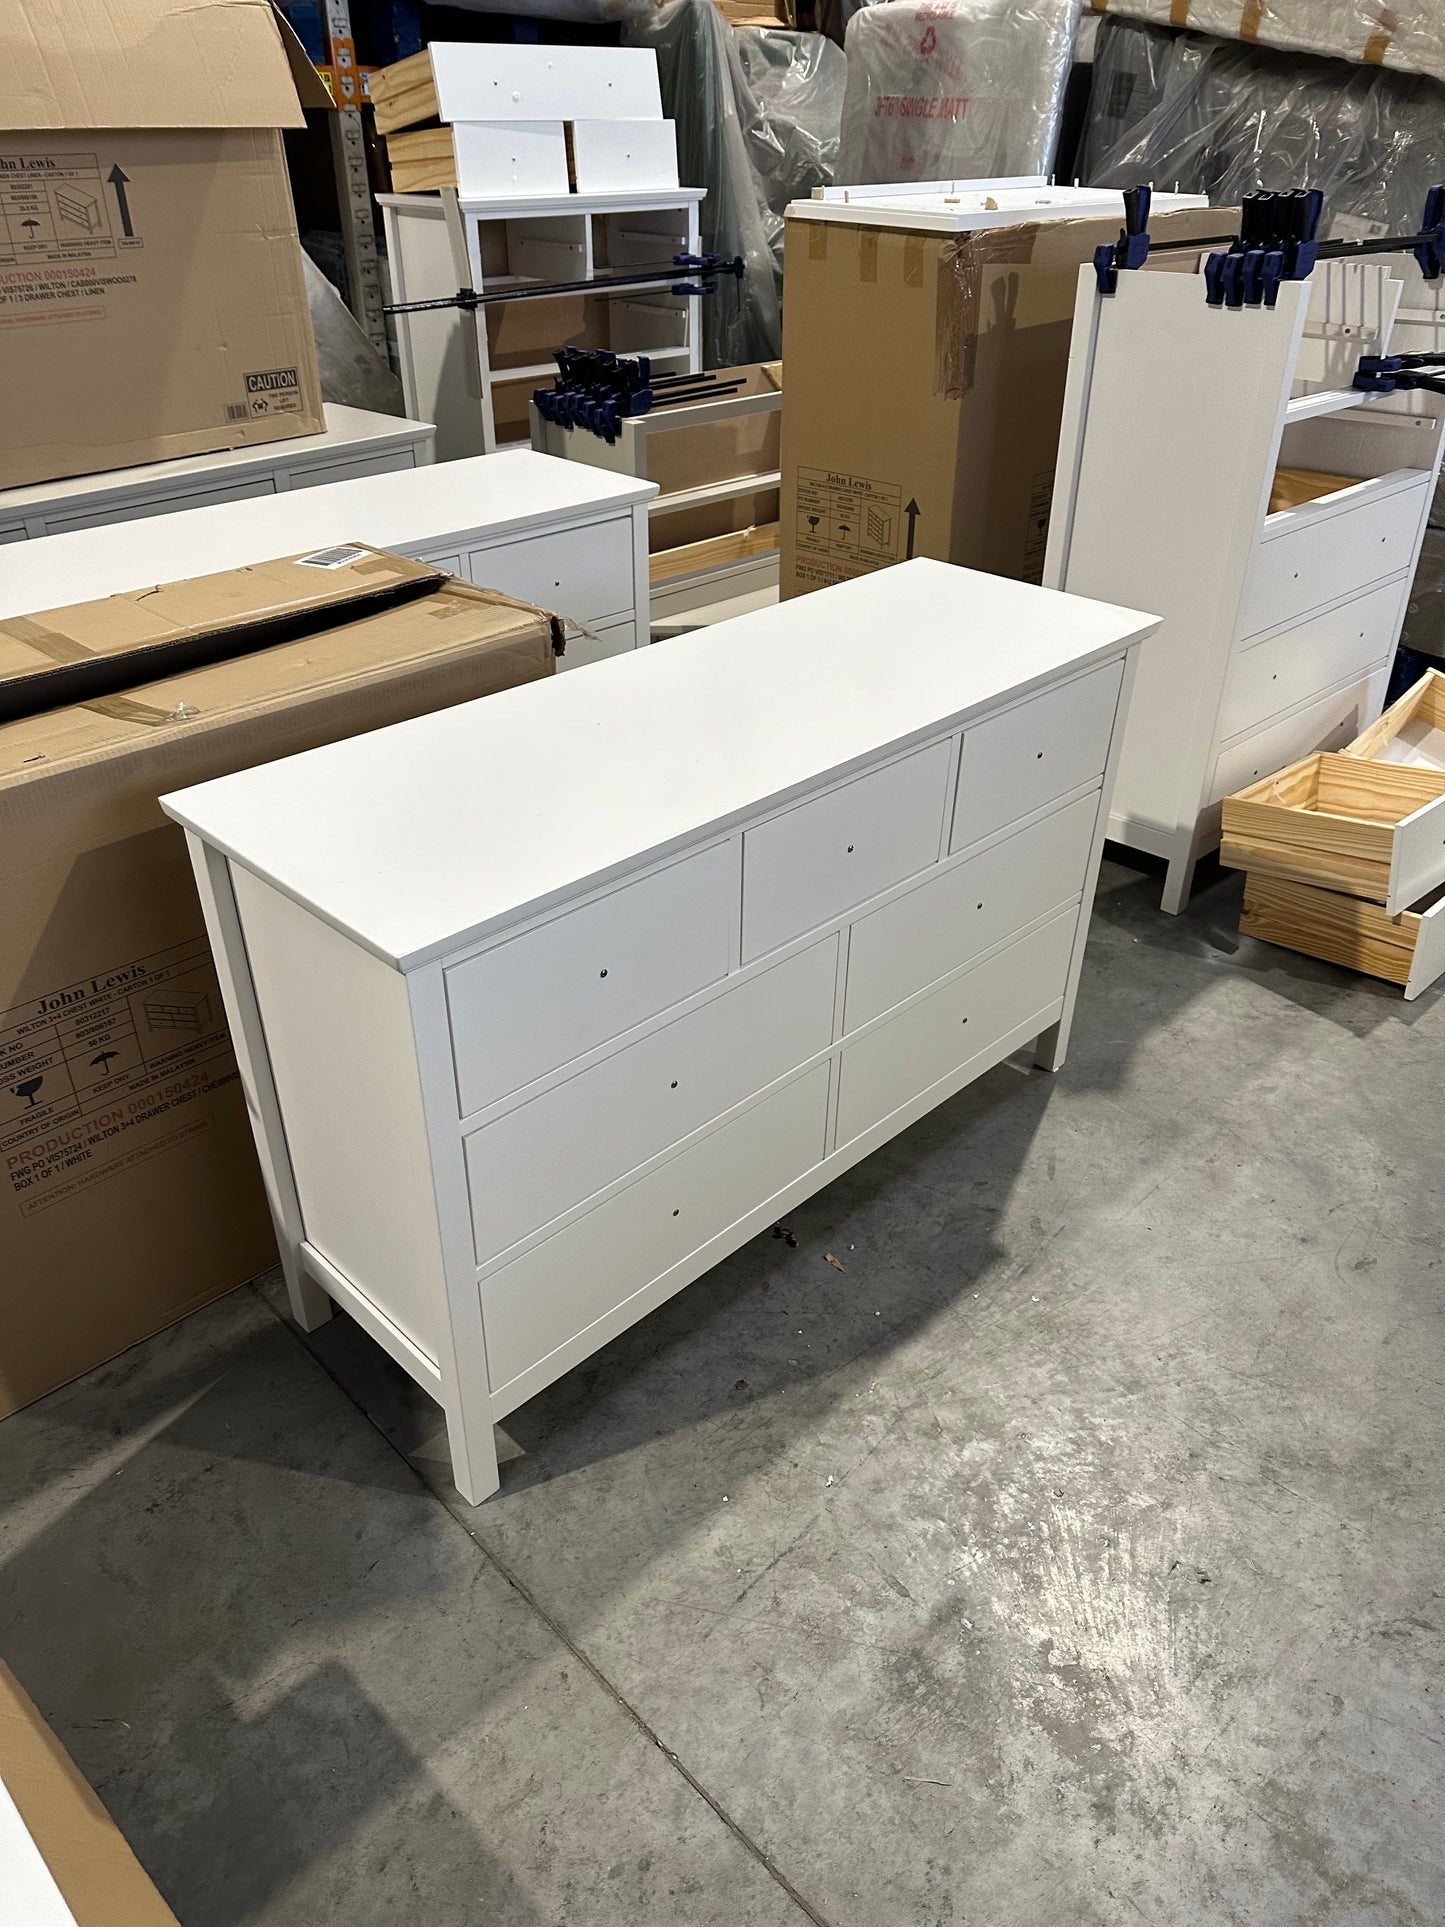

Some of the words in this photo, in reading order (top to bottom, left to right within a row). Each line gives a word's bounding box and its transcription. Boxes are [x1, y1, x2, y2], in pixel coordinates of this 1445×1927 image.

[900, 96, 938, 118] SINGLE
[0, 158, 16, 169] hn
[19, 157, 56, 169] Lewis
[0, 271, 41, 284] UCTION
[44, 267, 96, 280] 000150424
[39, 280, 66, 291] WILTON
[25, 291, 56, 301] DRAWER
[57, 289, 79, 298] CHEST
[85, 288, 105, 296] LINEN
[248, 371, 296, 391] CAUTION
[826, 473, 846, 486] John
[848, 477, 872, 491] Lewis
[796, 555, 842, 573] PRODUCTION
[38, 989, 86, 1014] John
[90, 964, 146, 993] Lewis
[16, 1018, 48, 1035] WILTON
[48, 1013, 62, 1023] 3+4
[62, 1003, 87, 1018] CHEST
[88, 993, 113, 1006] WHITE
[118, 978, 148, 994] CARTON
[154, 972, 165, 982] OF
[8, 1042, 23, 1052] NO
[99, 1034, 111, 1043] KG
[0, 1052, 34, 1072] UMBER
[149, 1050, 184, 1069] WARNING
[185, 1041, 208, 1056] HEAVY
[0, 1073, 16, 1085] OSS
[16, 1056, 54, 1076] WEIGHT
[128, 1078, 150, 1090] MADE
[160, 1058, 196, 1077] MALAYSIA
[92, 1080, 114, 1094] KEEP
[114, 1074, 130, 1084] DRY
[6, 1110, 124, 1170] PRODUCTION
[128, 1071, 209, 1114] 000150424
[20, 1106, 54, 1126] FRAGILE
[2, 1126, 40, 1147] COUNTRY
[40, 1122, 51, 1130] OF
[52, 1108, 80, 1124] ORIGIN
[10, 1166, 31, 1182] FWG
[32, 1159, 45, 1171] PO
[46, 1142, 83, 1164] VIS75724
[88, 1125, 120, 1145] WILTON
[121, 1120, 135, 1130] 3+4
[136, 1102, 171, 1124] DRAWER
[172, 1090, 198, 1107] CHEST
[14, 1176, 34, 1192] BOX
[34, 1174, 40, 1182] 1
[41, 1166, 54, 1178] OF
[65, 1149, 93, 1168] WHITE
[28, 1184, 78, 1210] ATTENTION:
[79, 1160, 125, 1185] HARDWARE
[126, 1140, 167, 1162] ATTACHED
